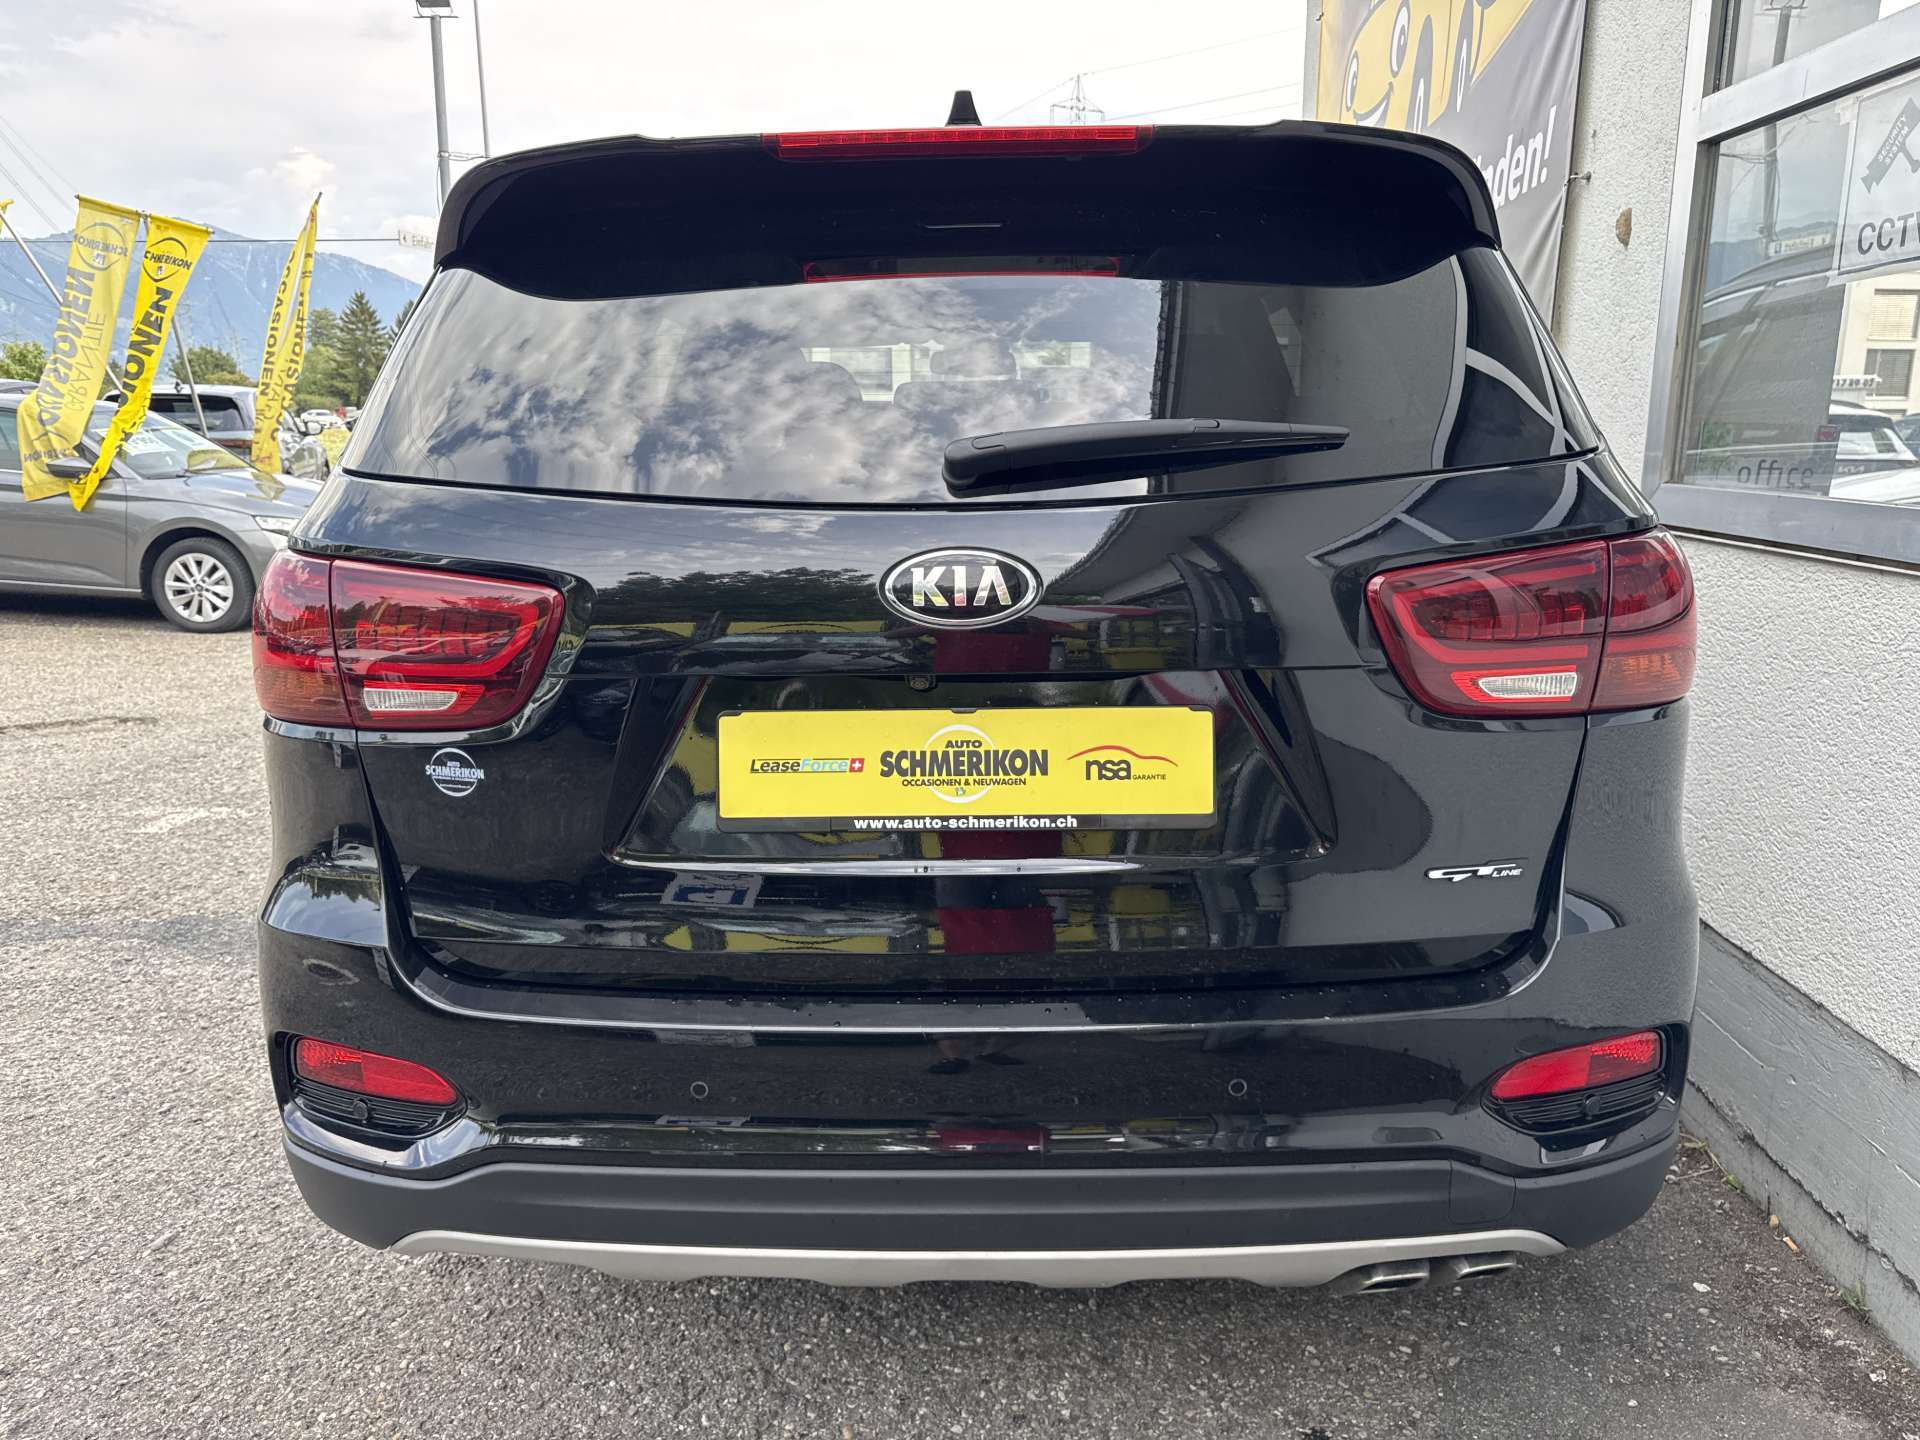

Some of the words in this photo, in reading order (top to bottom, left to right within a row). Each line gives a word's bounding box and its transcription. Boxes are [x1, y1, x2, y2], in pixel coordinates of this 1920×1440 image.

[1877, 113, 1907, 162] SECURITY
[1884, 125, 1910, 167] SYSTEM
[1736, 459, 1814, 489] office
[910, 565, 1012, 607] KIA
[945, 739, 983, 749] AUTO
[425, 764, 485, 780] SCHMERIKON
[751, 757, 849, 773] LeaseForce
[879, 749, 1049, 778] SCHMERIKON
[1085, 759, 1132, 781] nsa
[1132, 773, 1167, 781] GARANTIE
[902, 778, 962, 787] OCCASIONEN
[963, 777, 971, 787] &
[973, 777, 1027, 786] NEUWAGEN
[853, 815, 1078, 829] www.auto-schmerikon.ch
[1491, 867, 1524, 878] LINE
